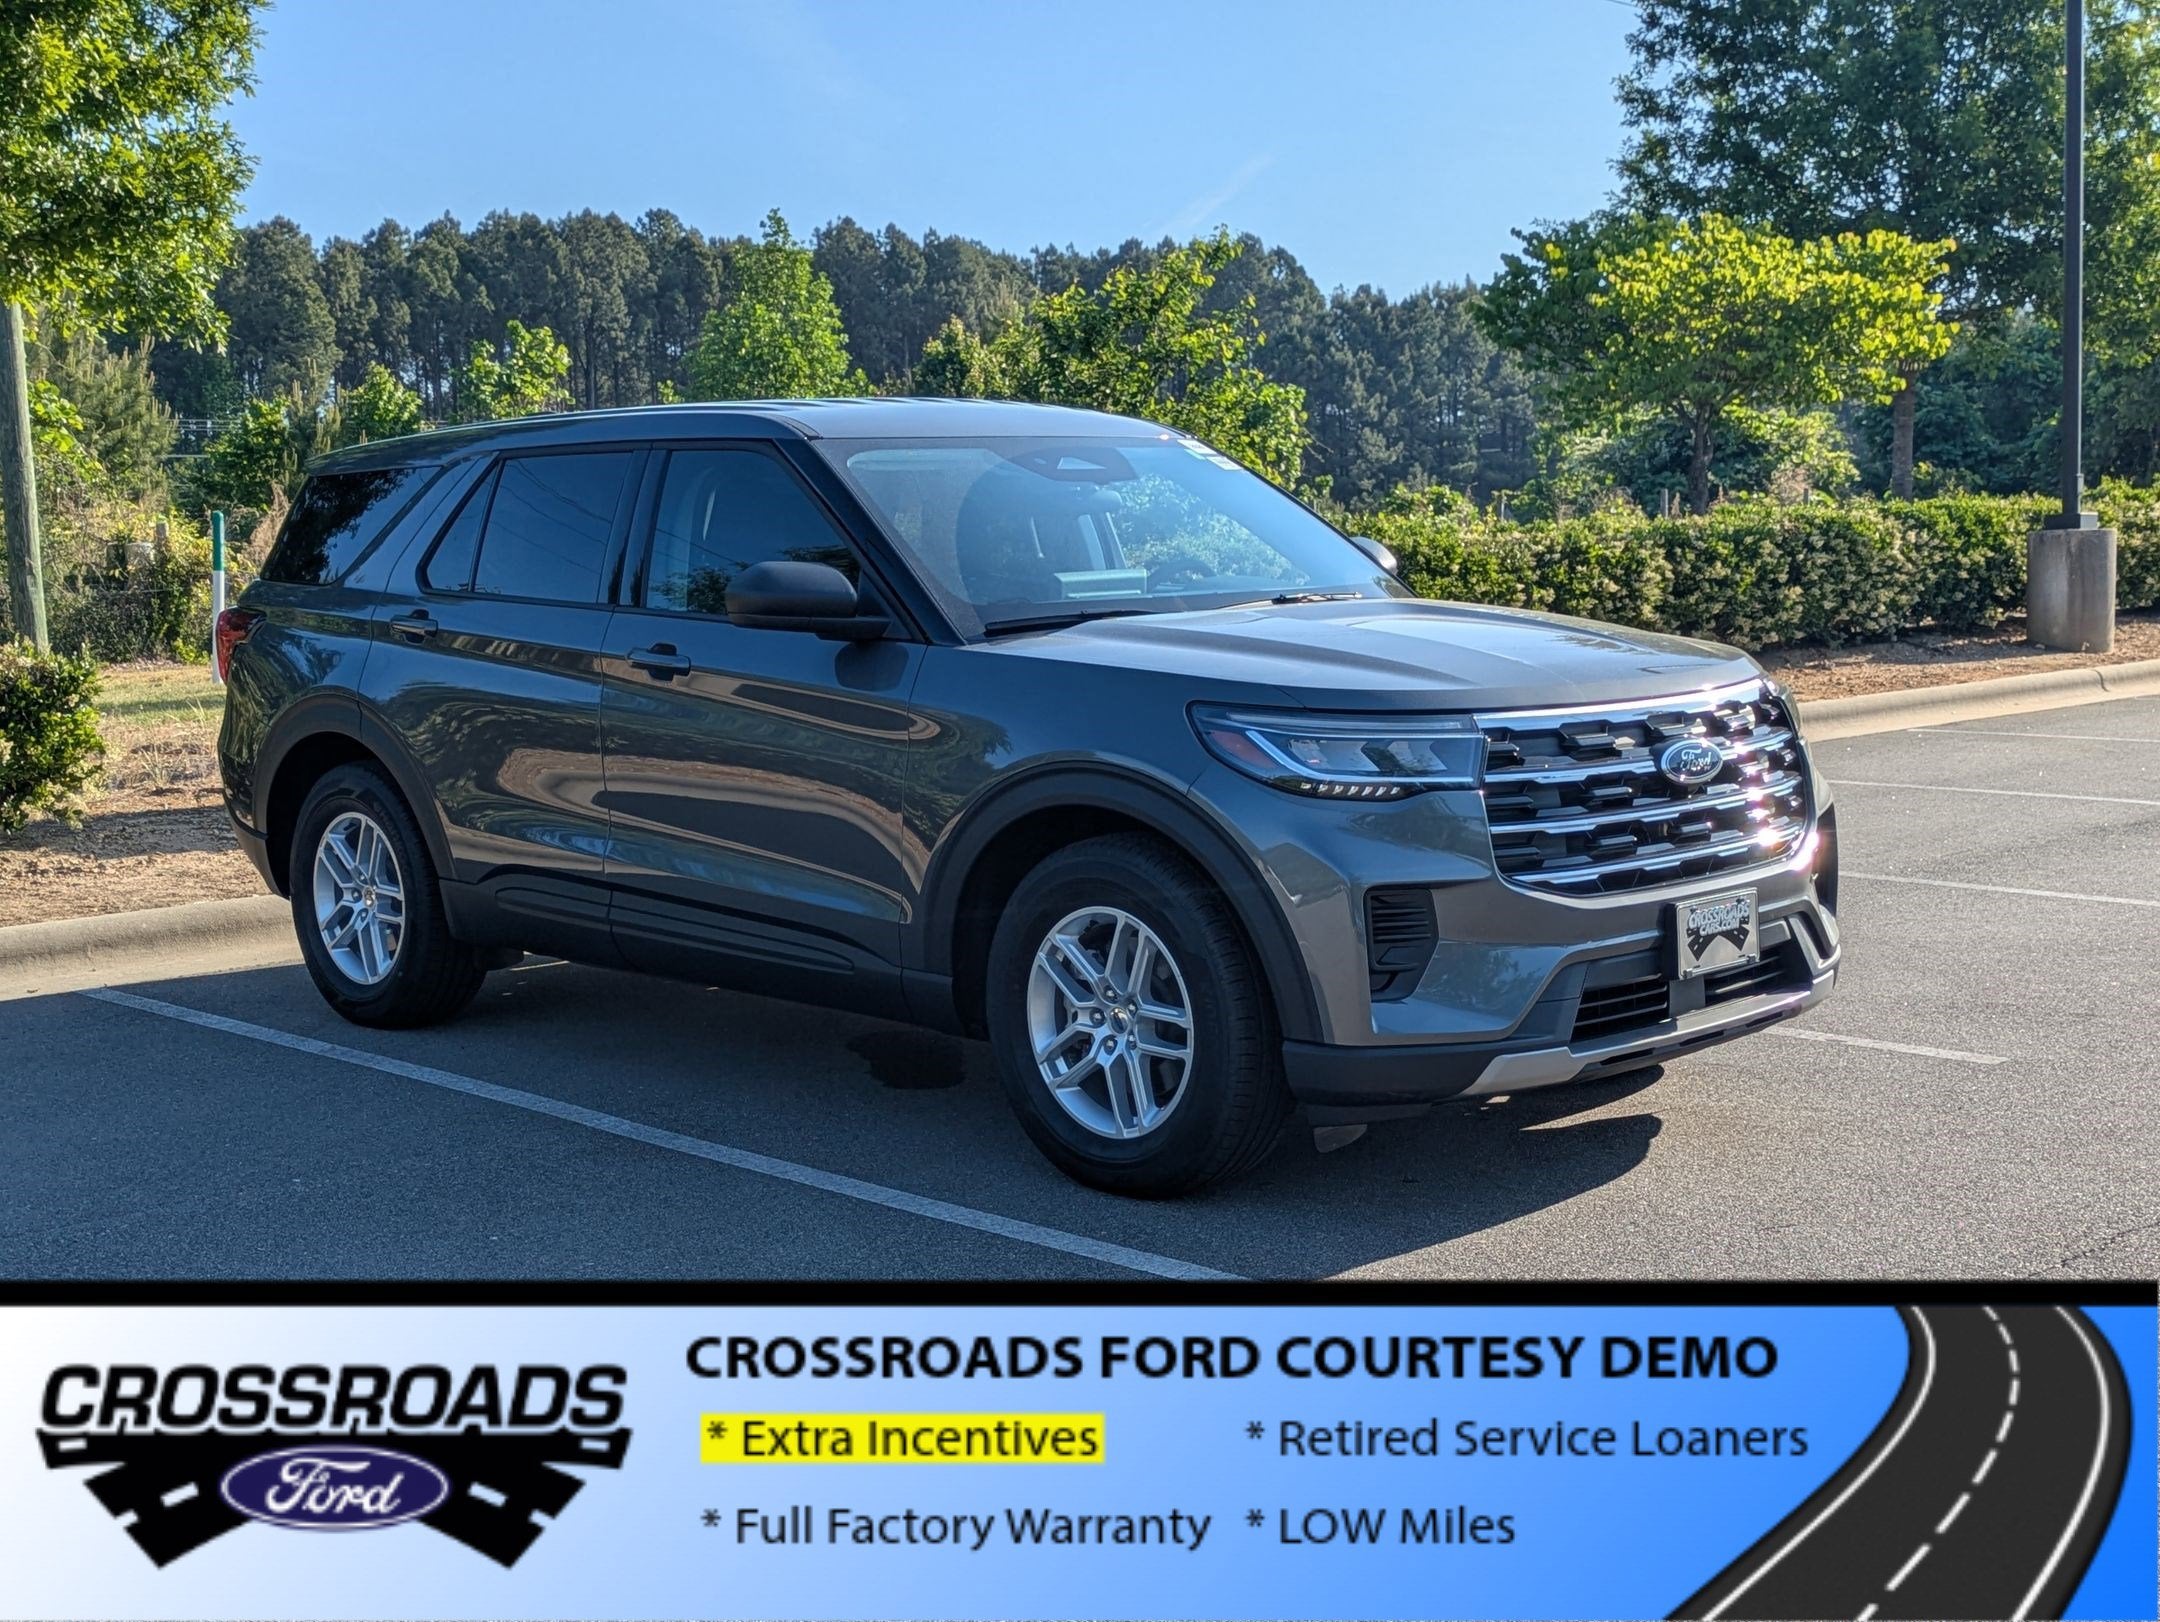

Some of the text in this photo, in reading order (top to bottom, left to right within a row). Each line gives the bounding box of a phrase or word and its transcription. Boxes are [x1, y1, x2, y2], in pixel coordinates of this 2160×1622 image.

[1680, 747, 1712, 771] Ford
[1688, 901, 1750, 929] CROSSROADS
[1699, 917, 1741, 937] CARS.COM
